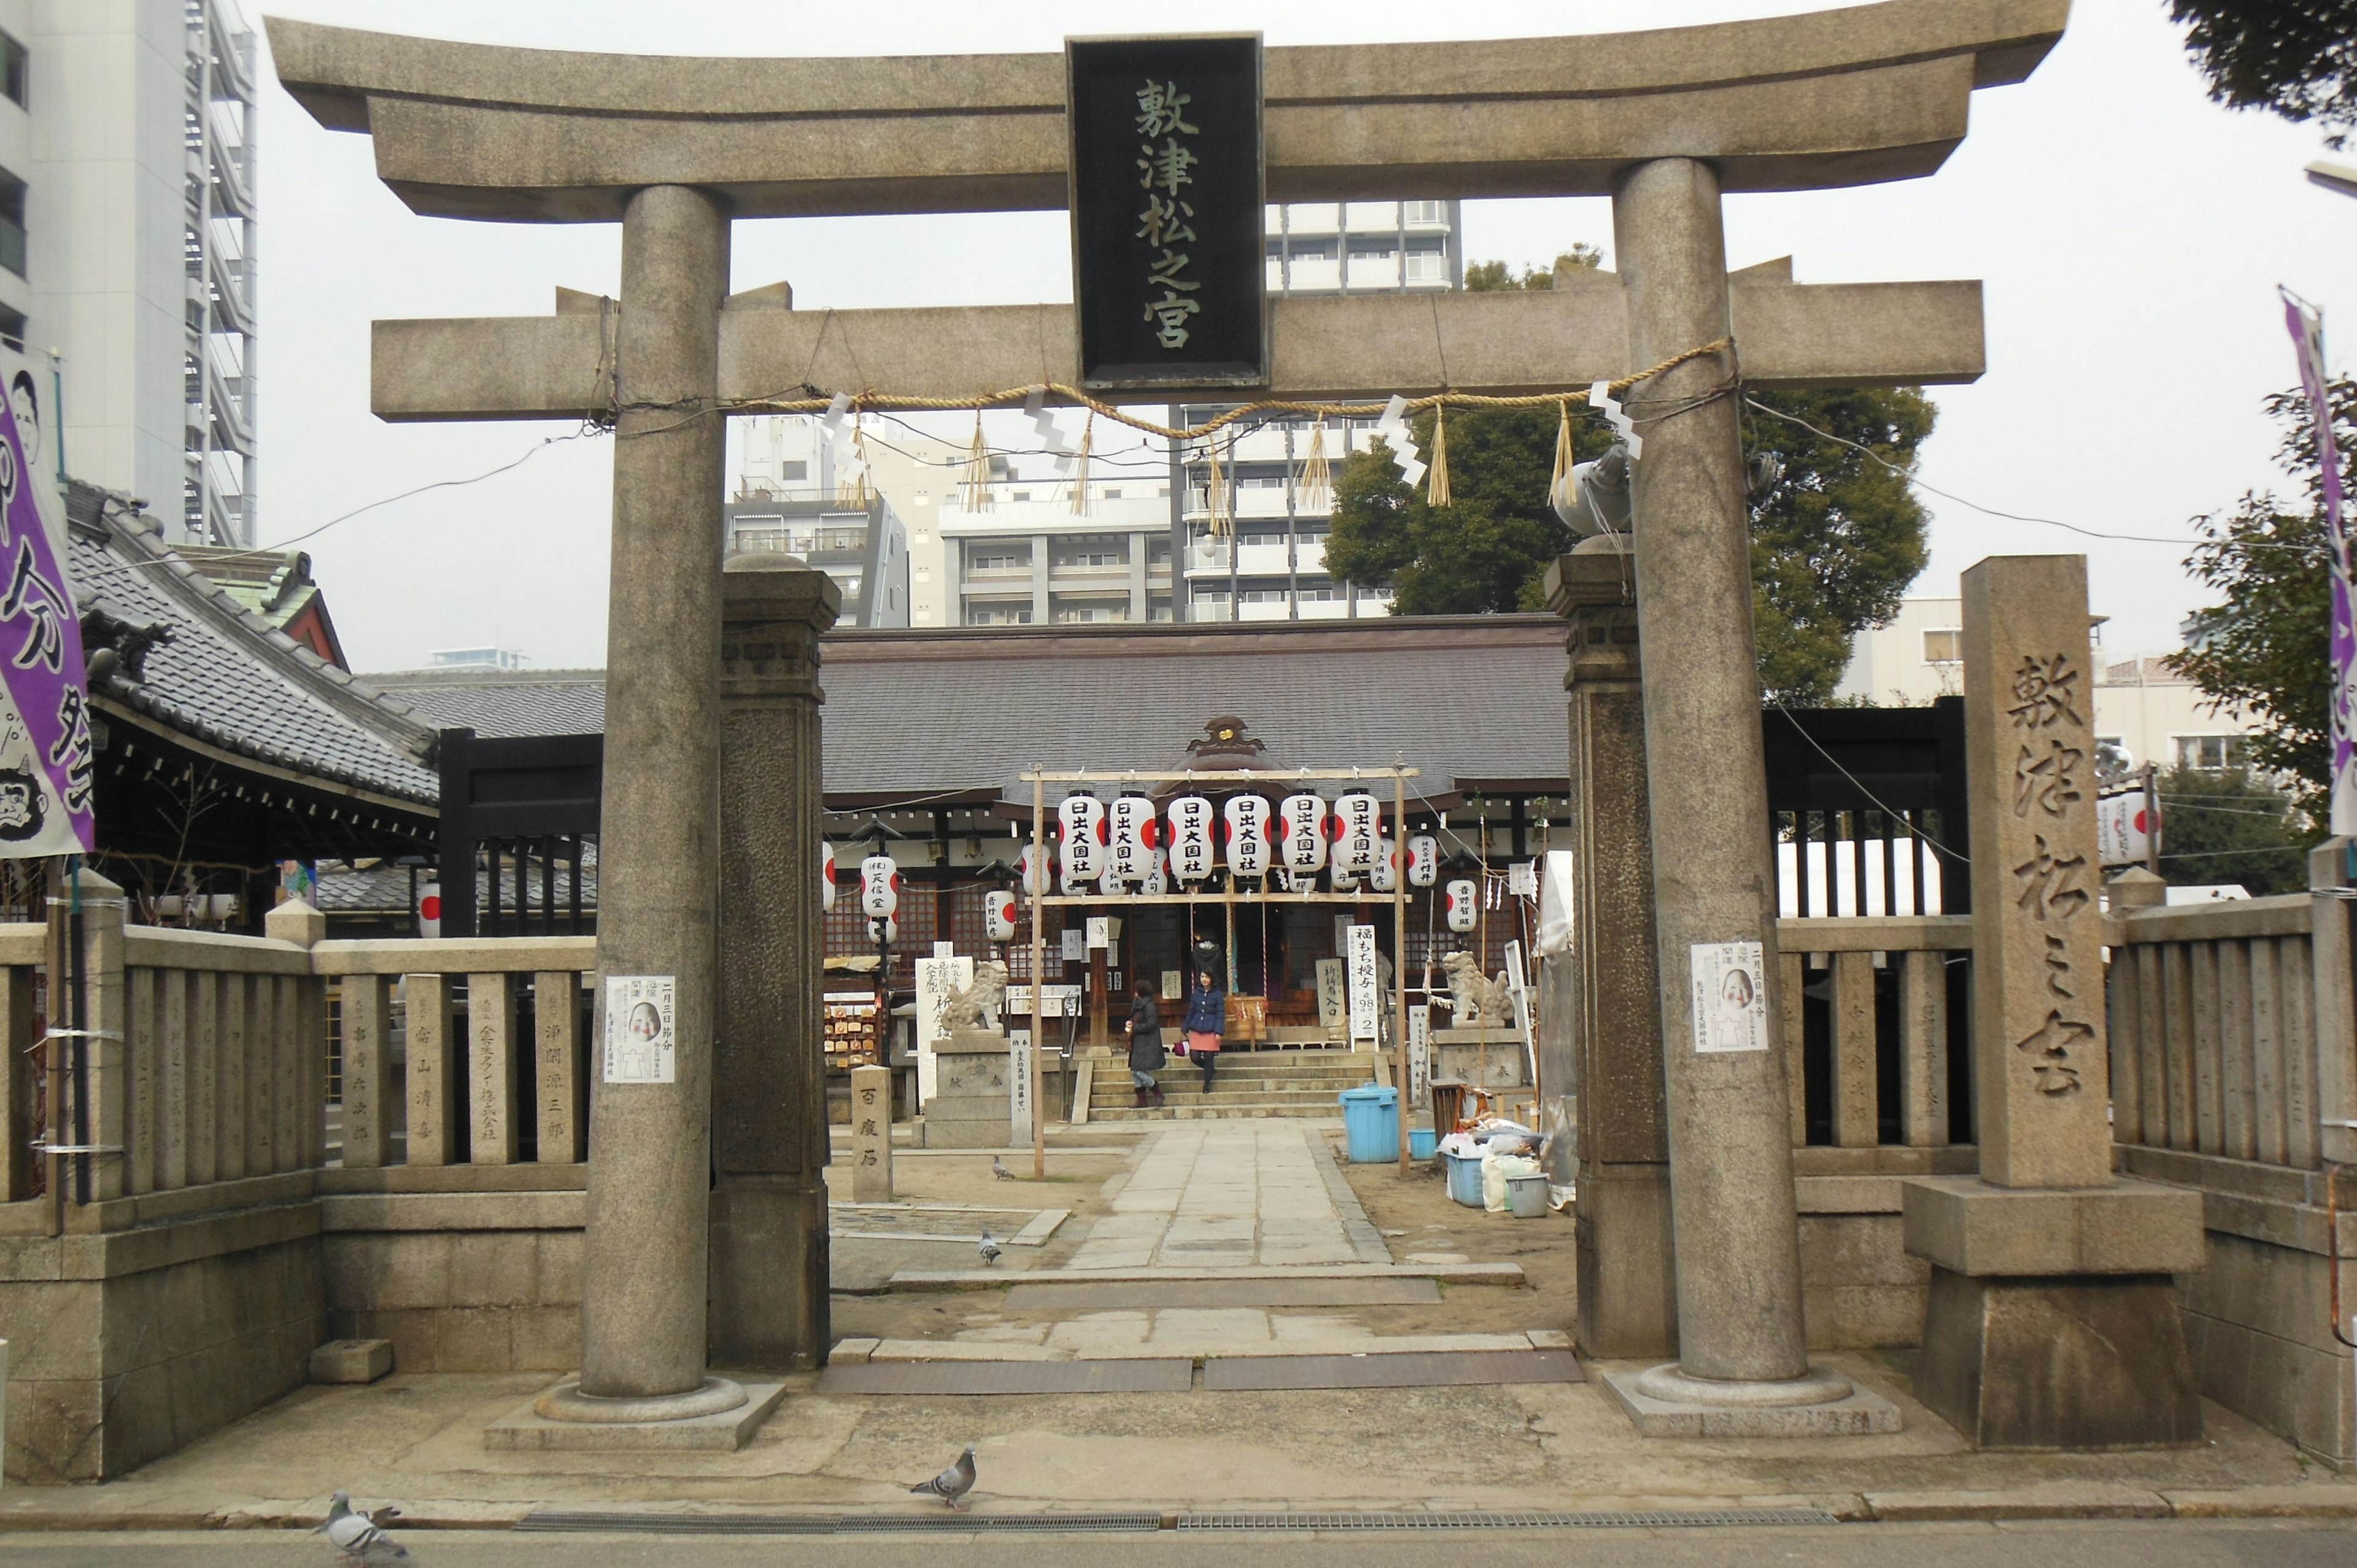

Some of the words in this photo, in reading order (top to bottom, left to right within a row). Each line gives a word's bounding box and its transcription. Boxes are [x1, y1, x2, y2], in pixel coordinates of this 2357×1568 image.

[1135, 79, 1202, 349] 敷津松之宮
[1071, 802, 1090, 873] 日出大国社
[1117, 802, 1134, 875] 日出大国社
[1183, 803, 1202, 871] 日出大国社
[1238, 800, 1258, 871] 日出大国社
[1295, 800, 1315, 866] 日出大国社
[1350, 800, 1371, 865] 日出大国社
[871, 873, 884, 908] 天信堂
[1356, 929, 1374, 988] 福もち授与
[662, 984, 672, 1051] 二月三日節分
[860, 1088, 878, 1166] 百度石
